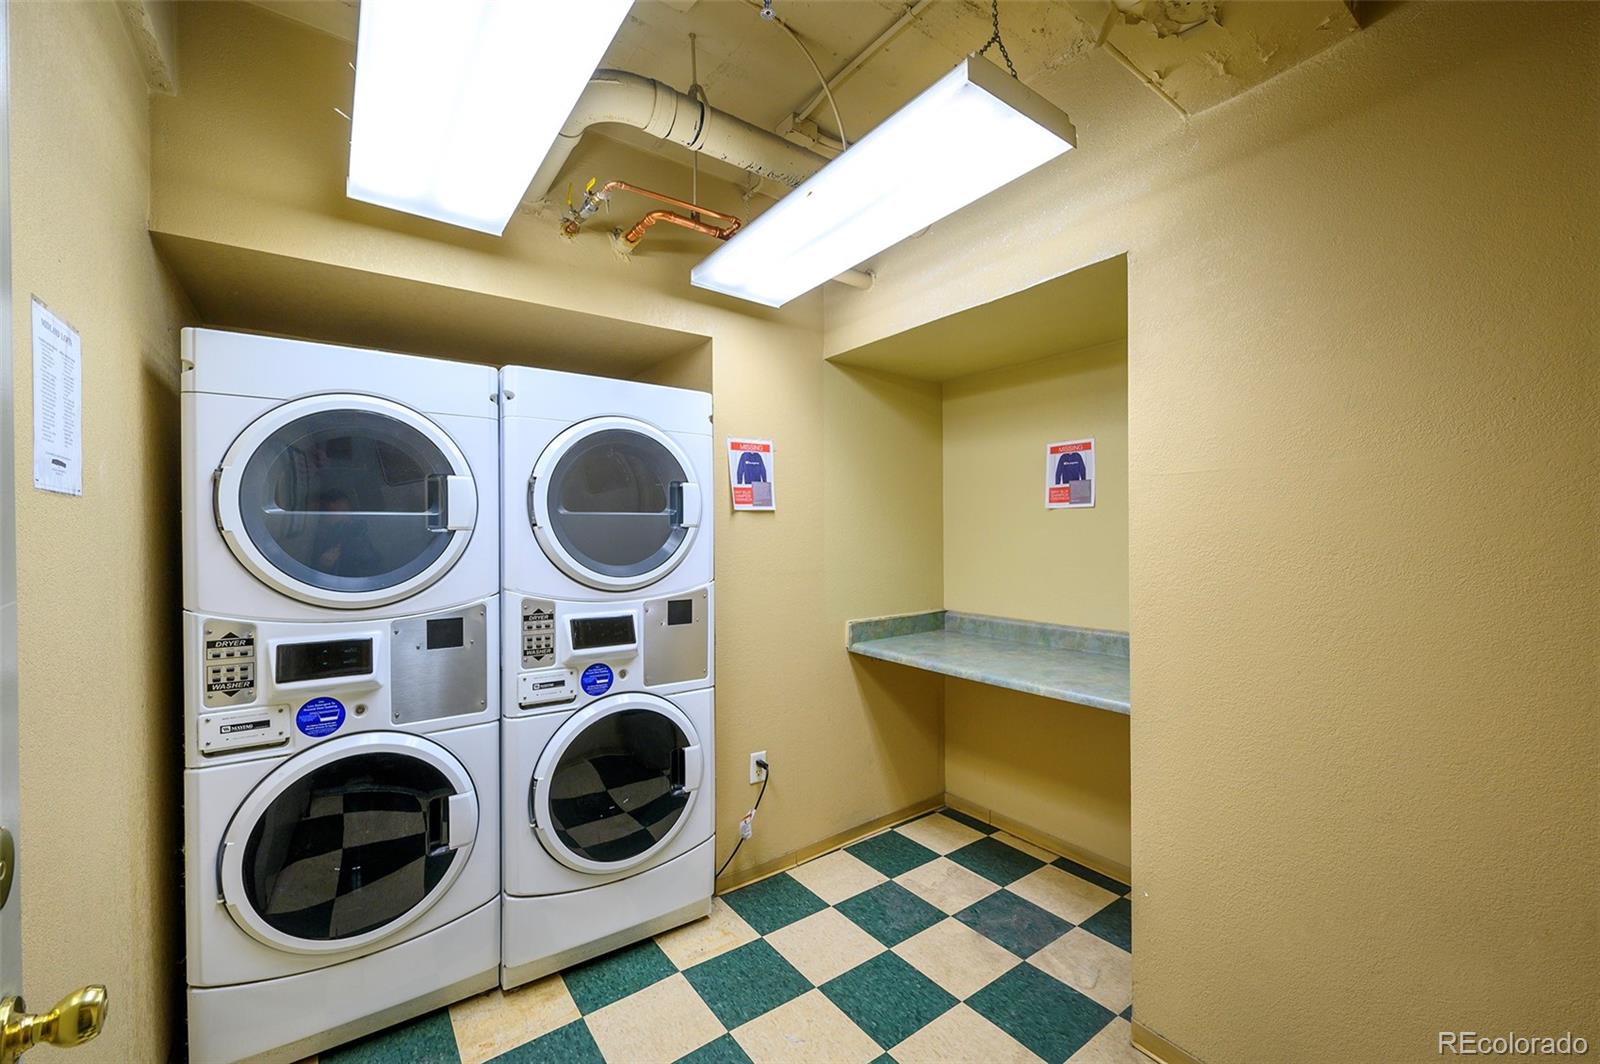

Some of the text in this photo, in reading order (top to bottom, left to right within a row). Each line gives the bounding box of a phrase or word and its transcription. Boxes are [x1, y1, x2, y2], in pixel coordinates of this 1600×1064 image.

[739, 442, 763, 451] MISSING
[1058, 444, 1083, 452] MISSING
[212, 681, 251, 690] WASHER
